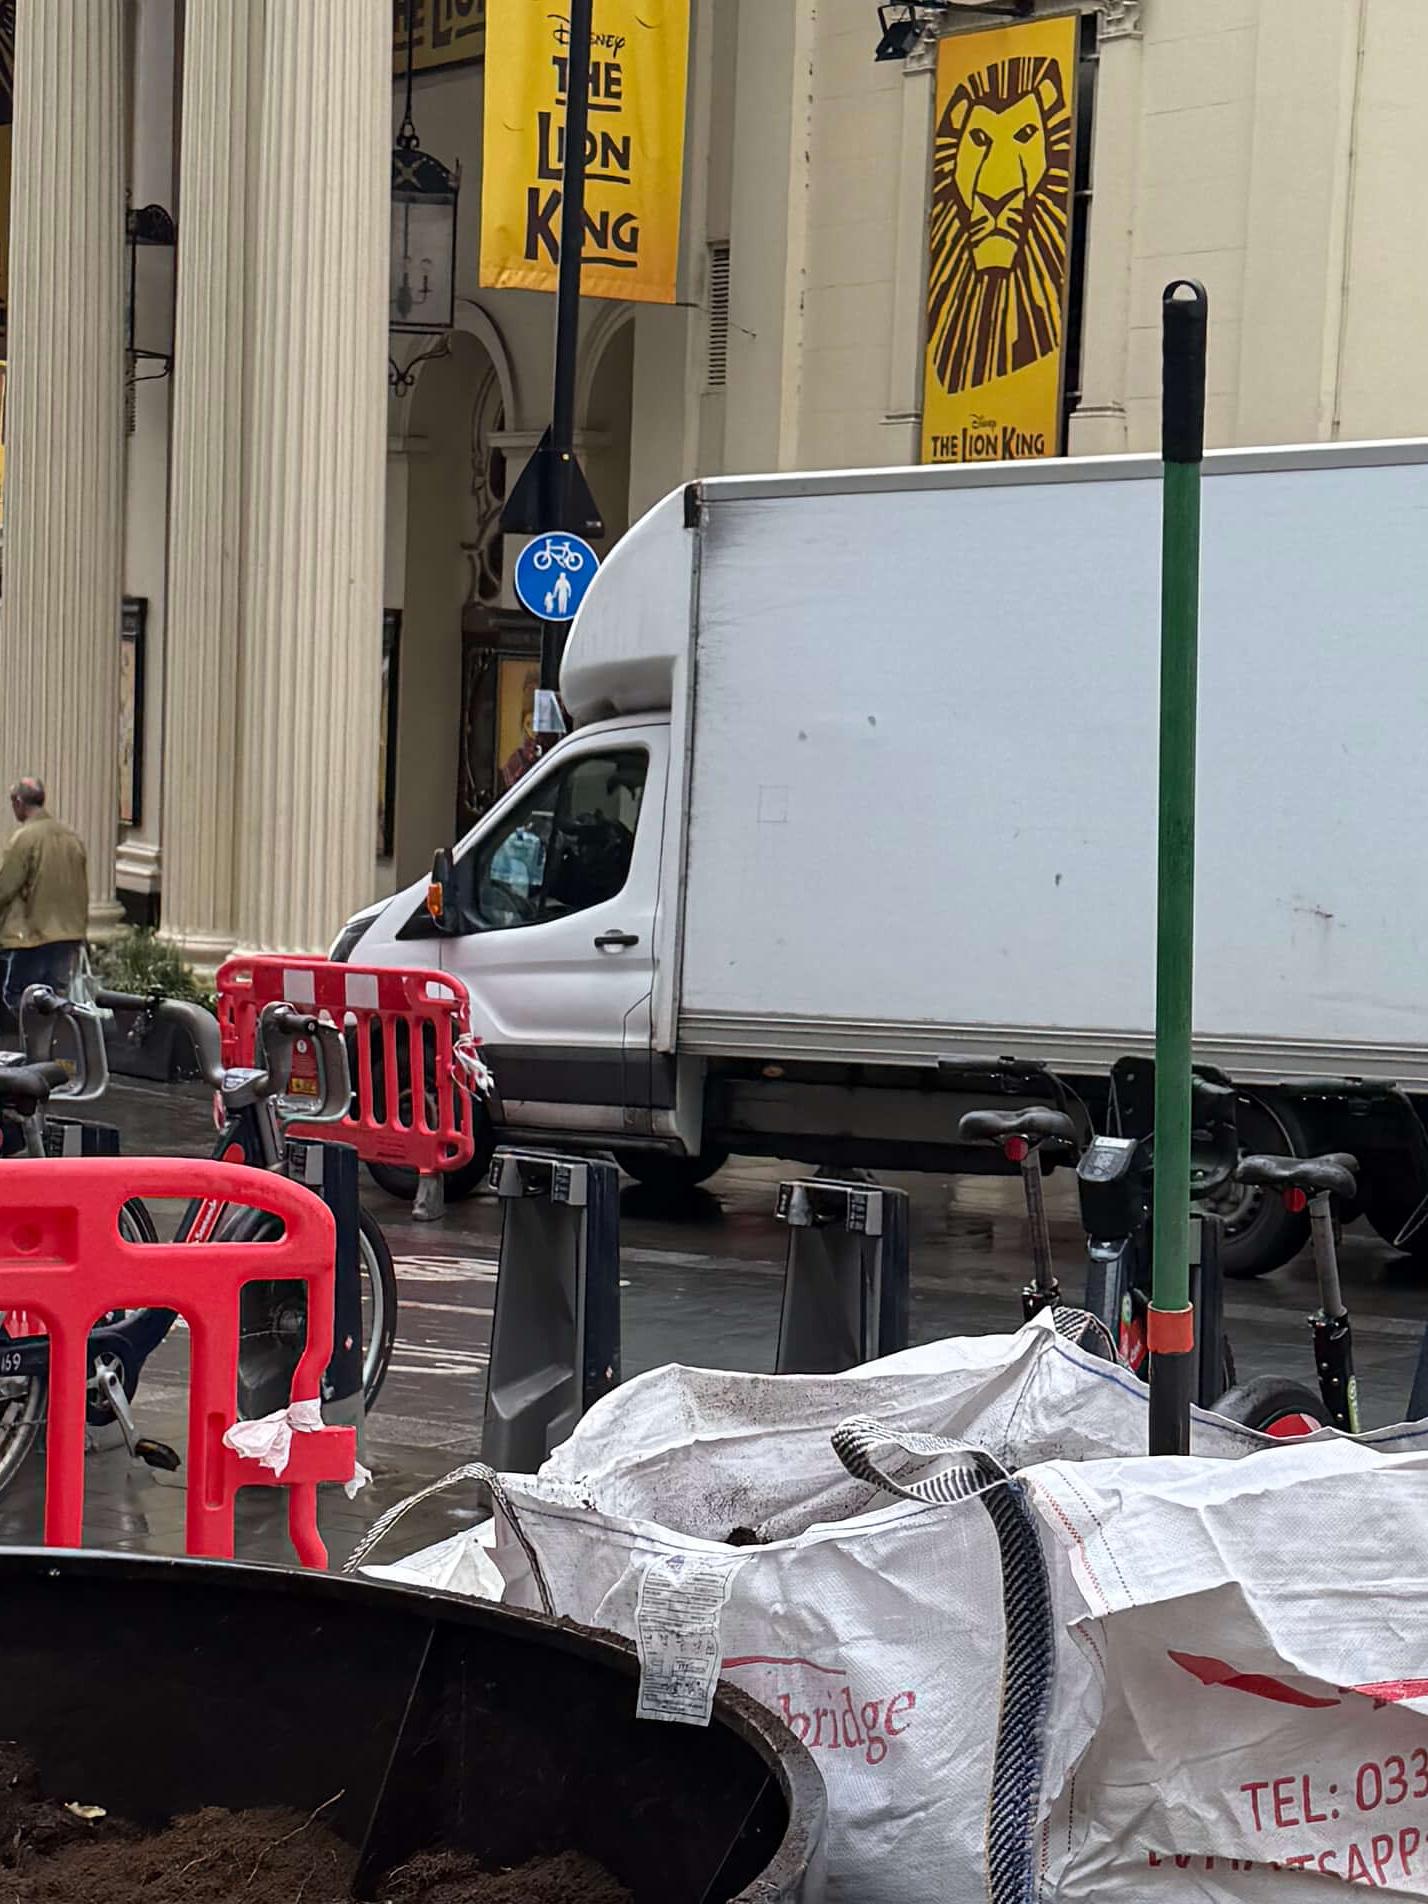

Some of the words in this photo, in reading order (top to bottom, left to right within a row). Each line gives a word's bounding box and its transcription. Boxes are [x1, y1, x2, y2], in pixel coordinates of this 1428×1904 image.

[546, 13, 626, 59] Dsney
[524, 187, 639, 265] KNG
[931, 434, 960, 458] THE
[961, 427, 998, 463] LION
[1002, 426, 1045, 460] KING
[1240, 1773, 1340, 1832] TEL:
